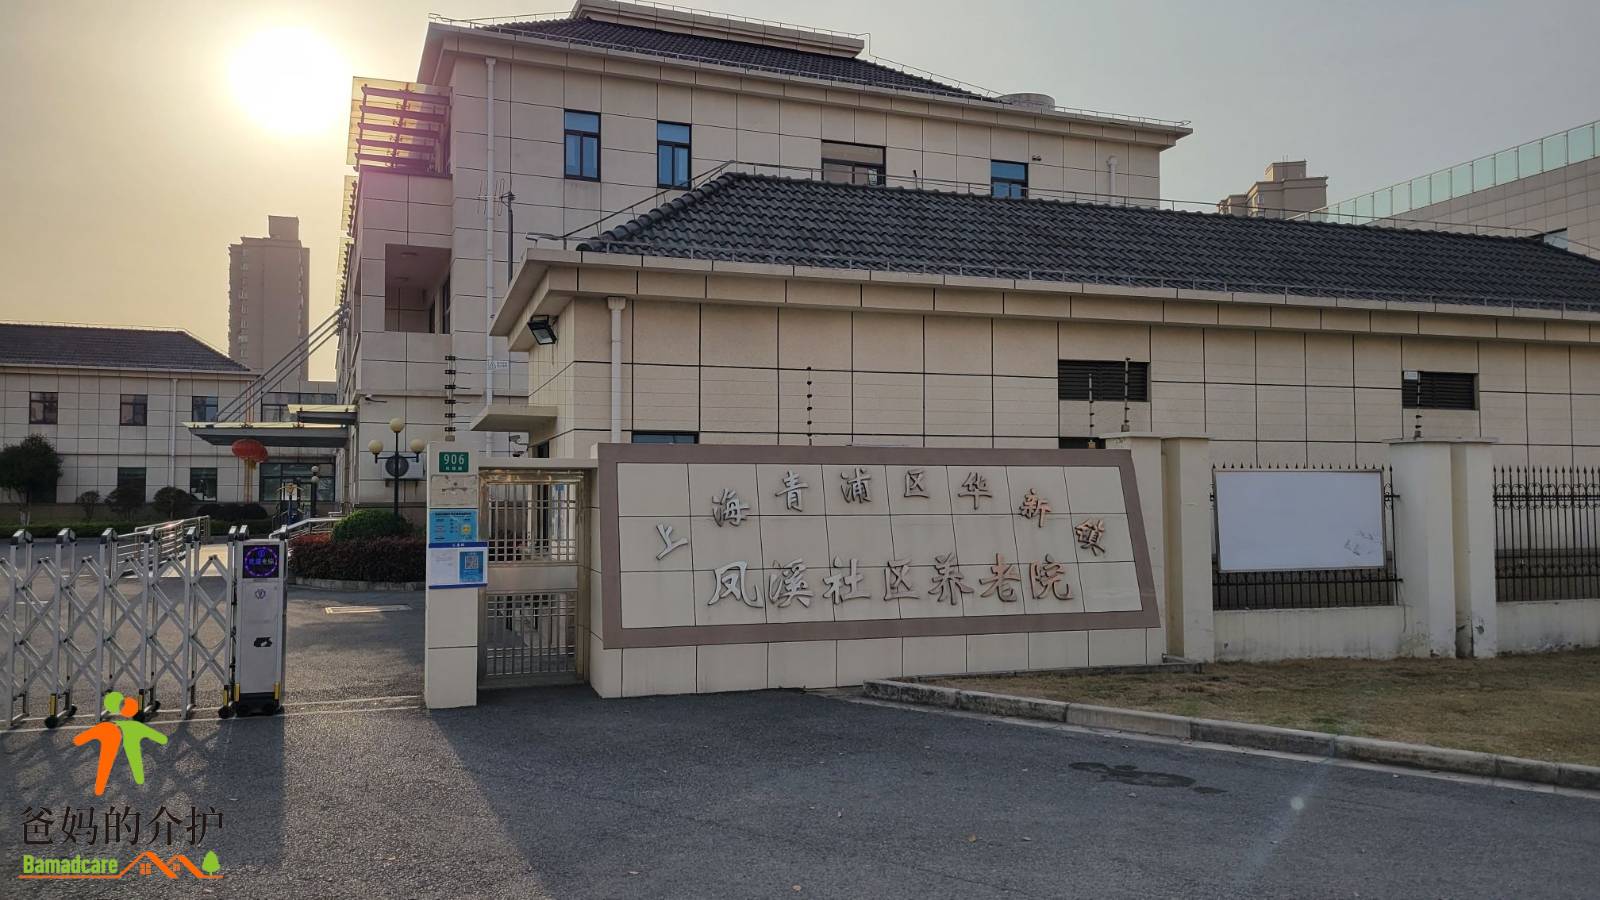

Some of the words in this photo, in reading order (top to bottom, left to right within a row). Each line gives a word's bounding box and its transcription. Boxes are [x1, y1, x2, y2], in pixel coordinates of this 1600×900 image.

[443, 454, 465, 465] 906
[708, 553, 1074, 609] 凤溪社区养老院
